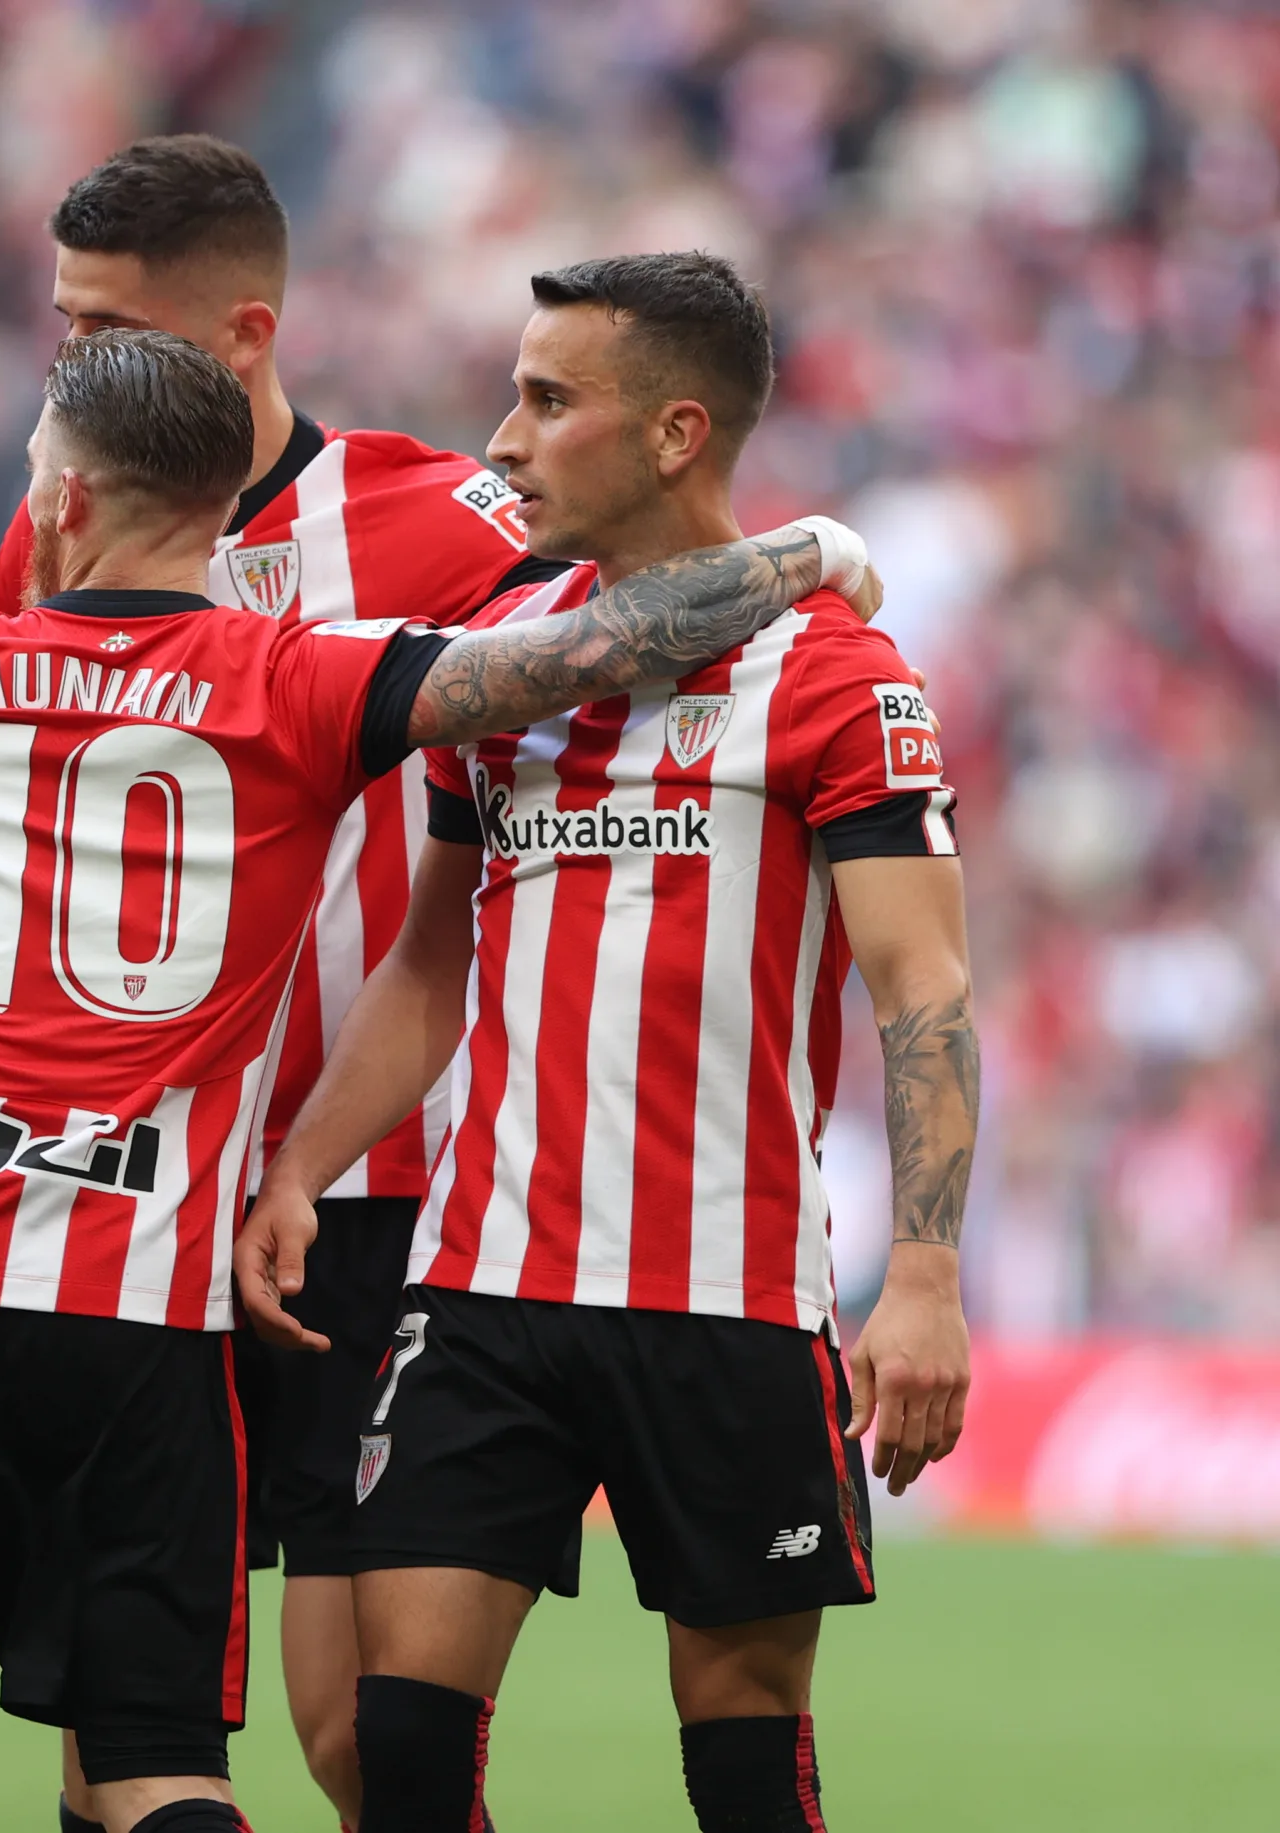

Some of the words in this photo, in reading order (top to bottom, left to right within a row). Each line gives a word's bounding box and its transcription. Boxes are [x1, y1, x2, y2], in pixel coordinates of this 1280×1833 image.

[235, 549, 270, 560] ATHLETIC
[272, 546, 292, 555] CLUB
[372, 1312, 431, 1426] 7
